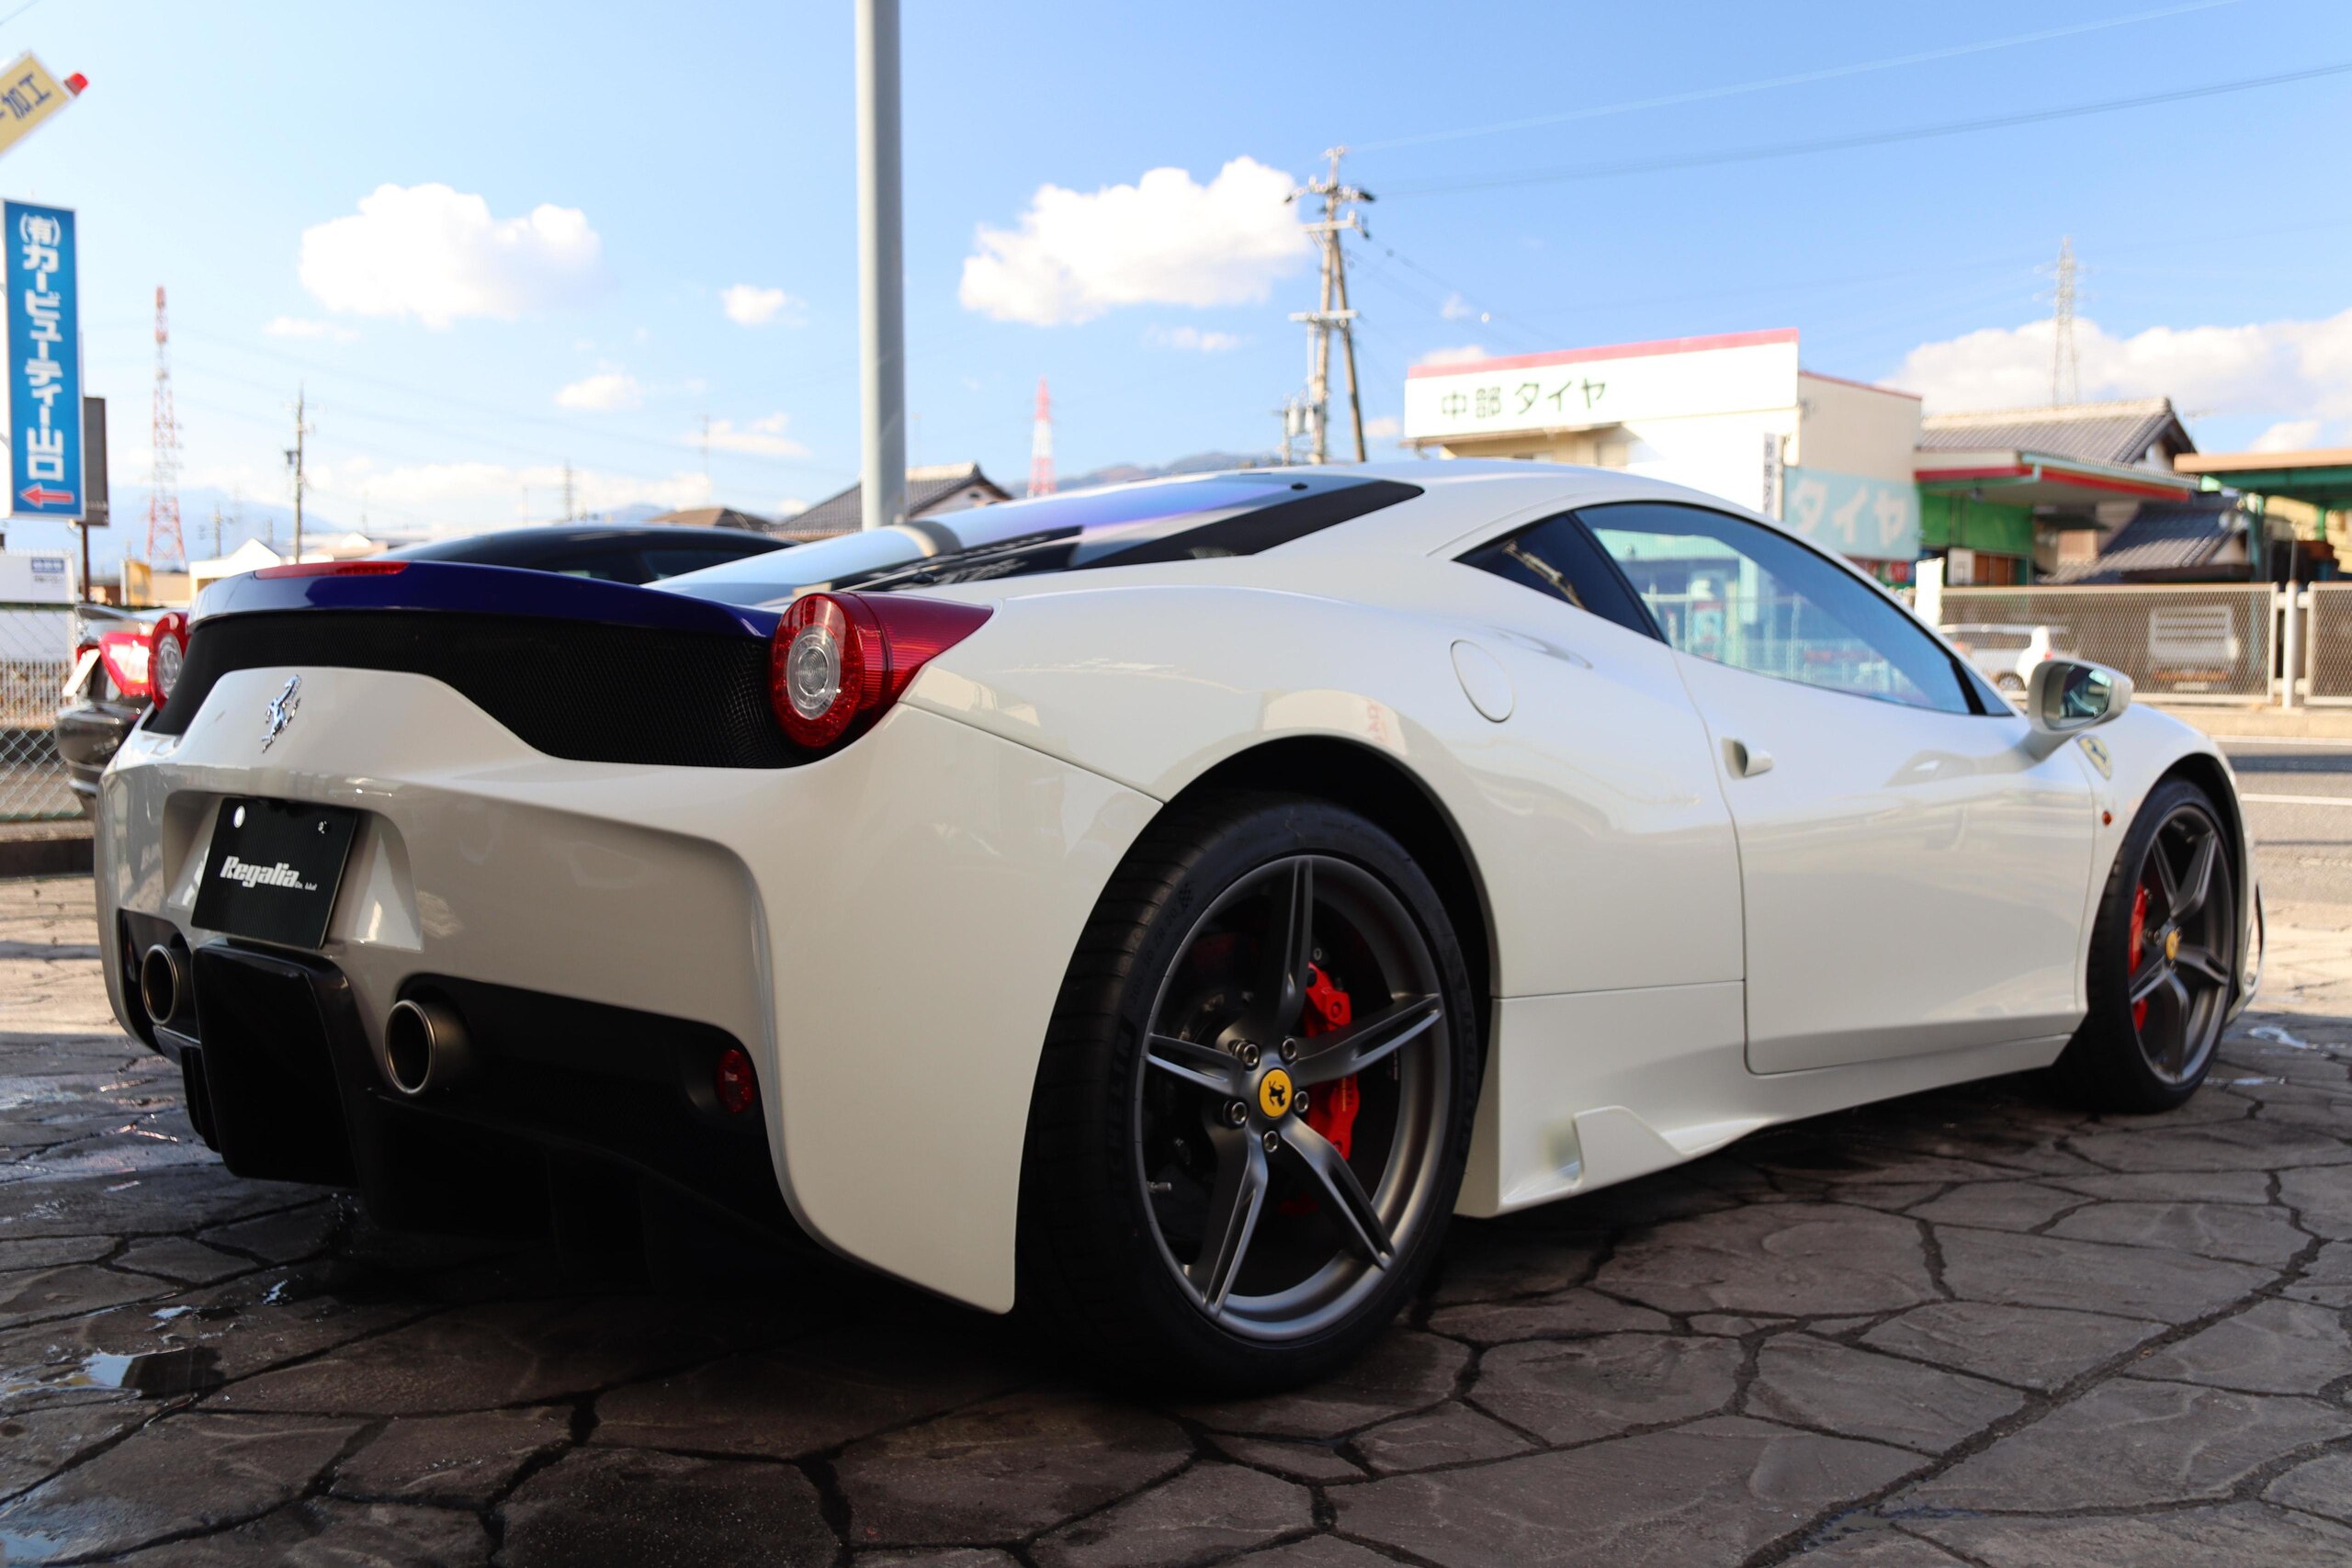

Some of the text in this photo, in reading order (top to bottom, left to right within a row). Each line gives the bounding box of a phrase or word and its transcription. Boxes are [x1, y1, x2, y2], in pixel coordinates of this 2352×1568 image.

[1792, 479, 1907, 548] タイヤ
[220, 855, 300, 888] Regalia
